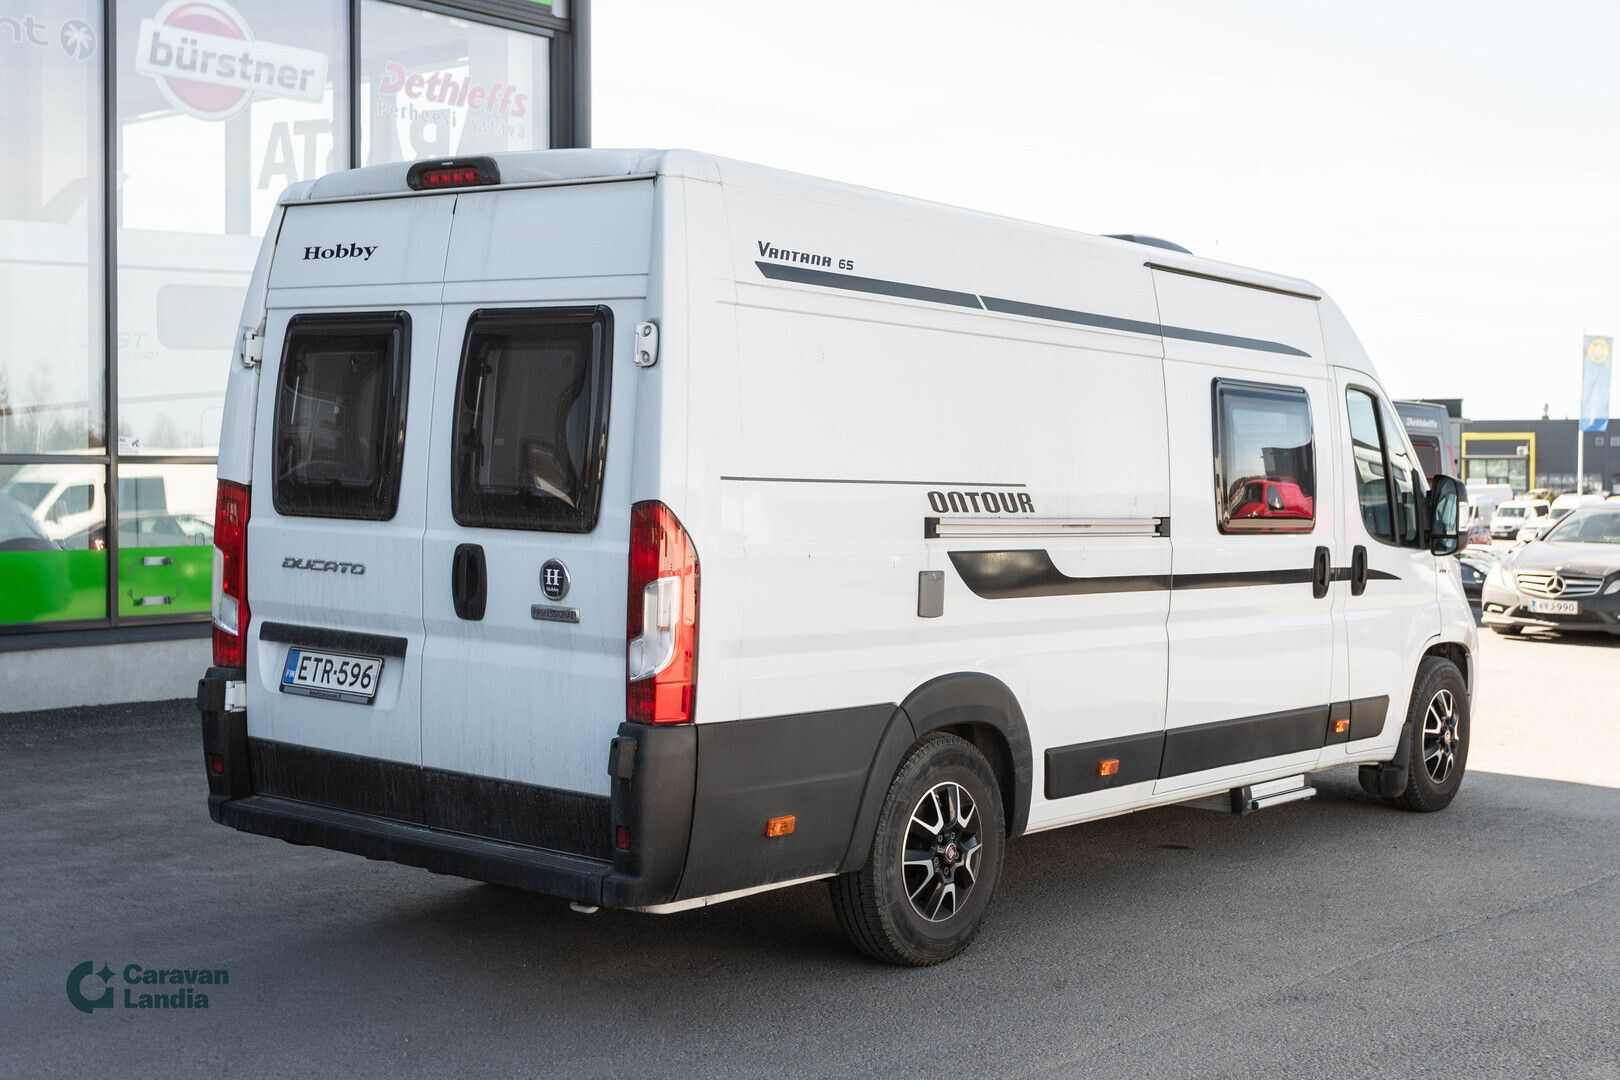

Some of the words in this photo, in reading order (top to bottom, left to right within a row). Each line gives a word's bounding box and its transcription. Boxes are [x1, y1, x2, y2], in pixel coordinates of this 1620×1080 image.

[149, 31, 315, 91] bürstner
[379, 61, 529, 118] Dethleffs
[303, 243, 379, 261] Hobby
[838, 259, 855, 270] 65
[282, 557, 367, 575] DUCATO
[297, 656, 374, 689] ETR-596
